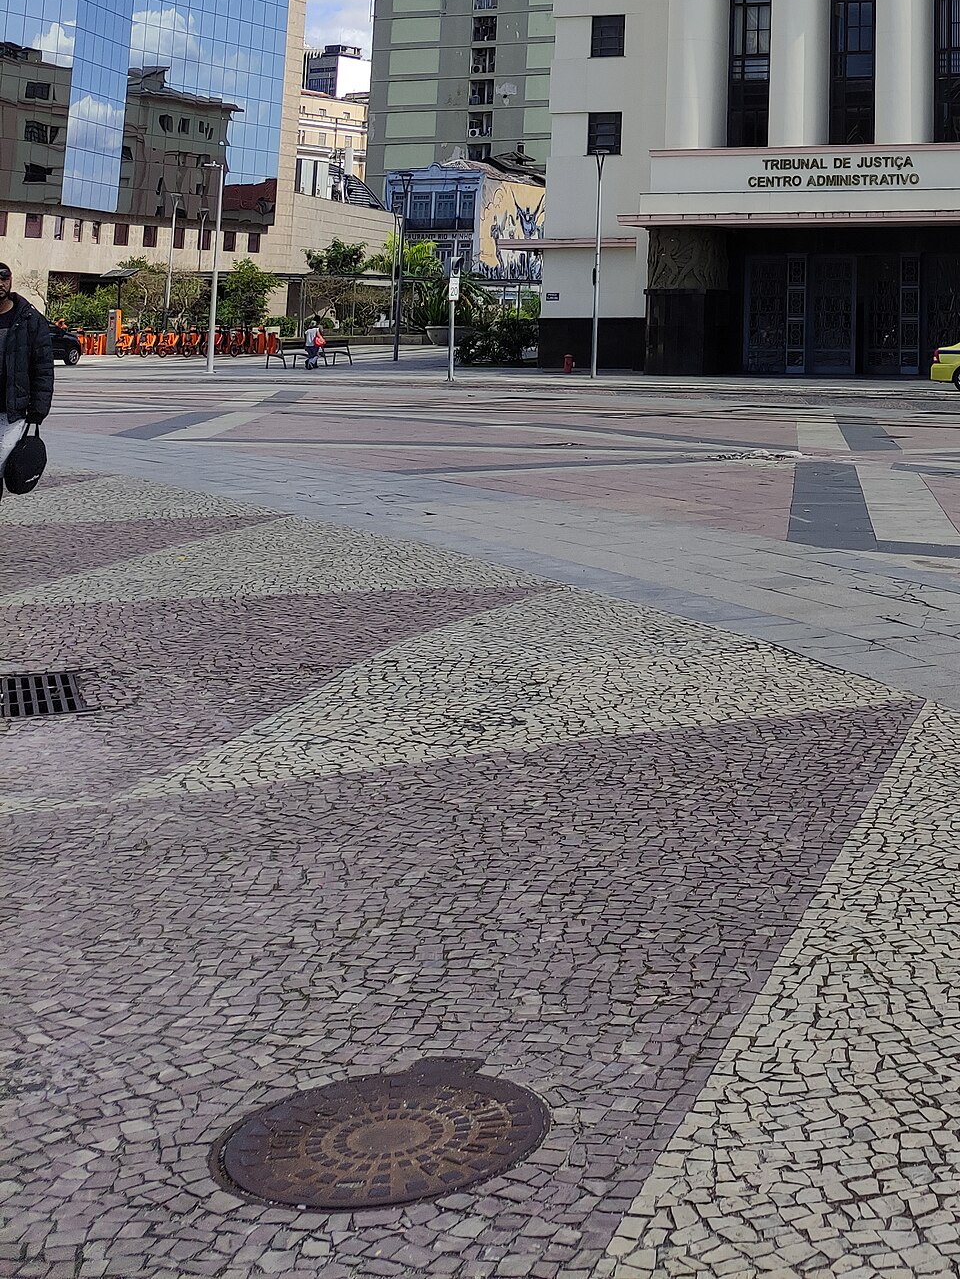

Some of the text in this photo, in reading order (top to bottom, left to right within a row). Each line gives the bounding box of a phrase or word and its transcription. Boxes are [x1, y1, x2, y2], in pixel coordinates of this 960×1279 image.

[762, 155, 914, 171] TRIBUNAL DE JUSTIÇA
[748, 173, 920, 188] CENTRO ADMINISTRATIVO
